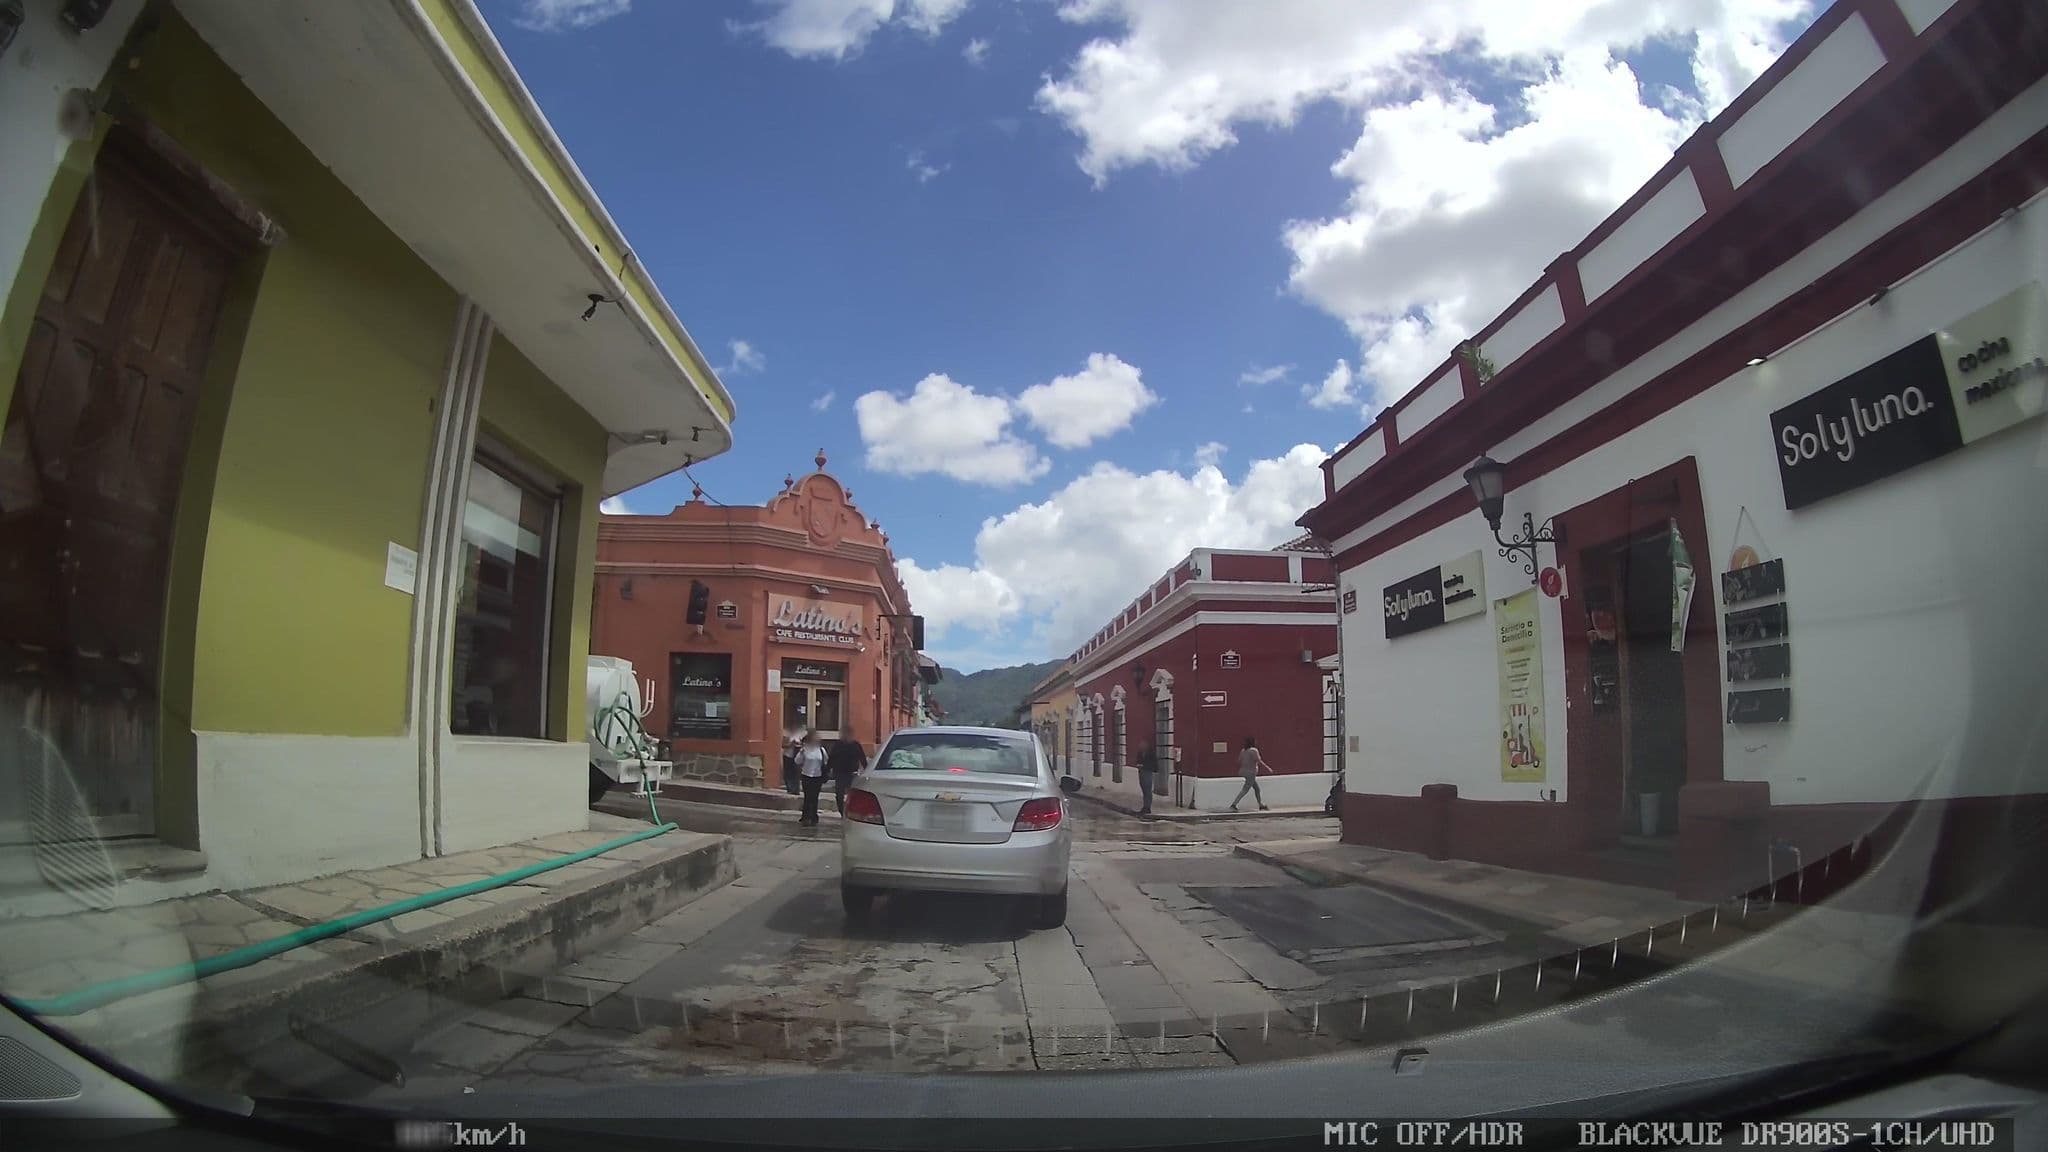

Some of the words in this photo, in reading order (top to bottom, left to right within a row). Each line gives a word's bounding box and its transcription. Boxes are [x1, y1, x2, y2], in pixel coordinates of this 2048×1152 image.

[773, 599, 863, 635] Latino's
[794, 631, 836, 642] RESTAURANTE
[838, 635, 854, 644] CLUB
[682, 675, 722, 688] Latino's
